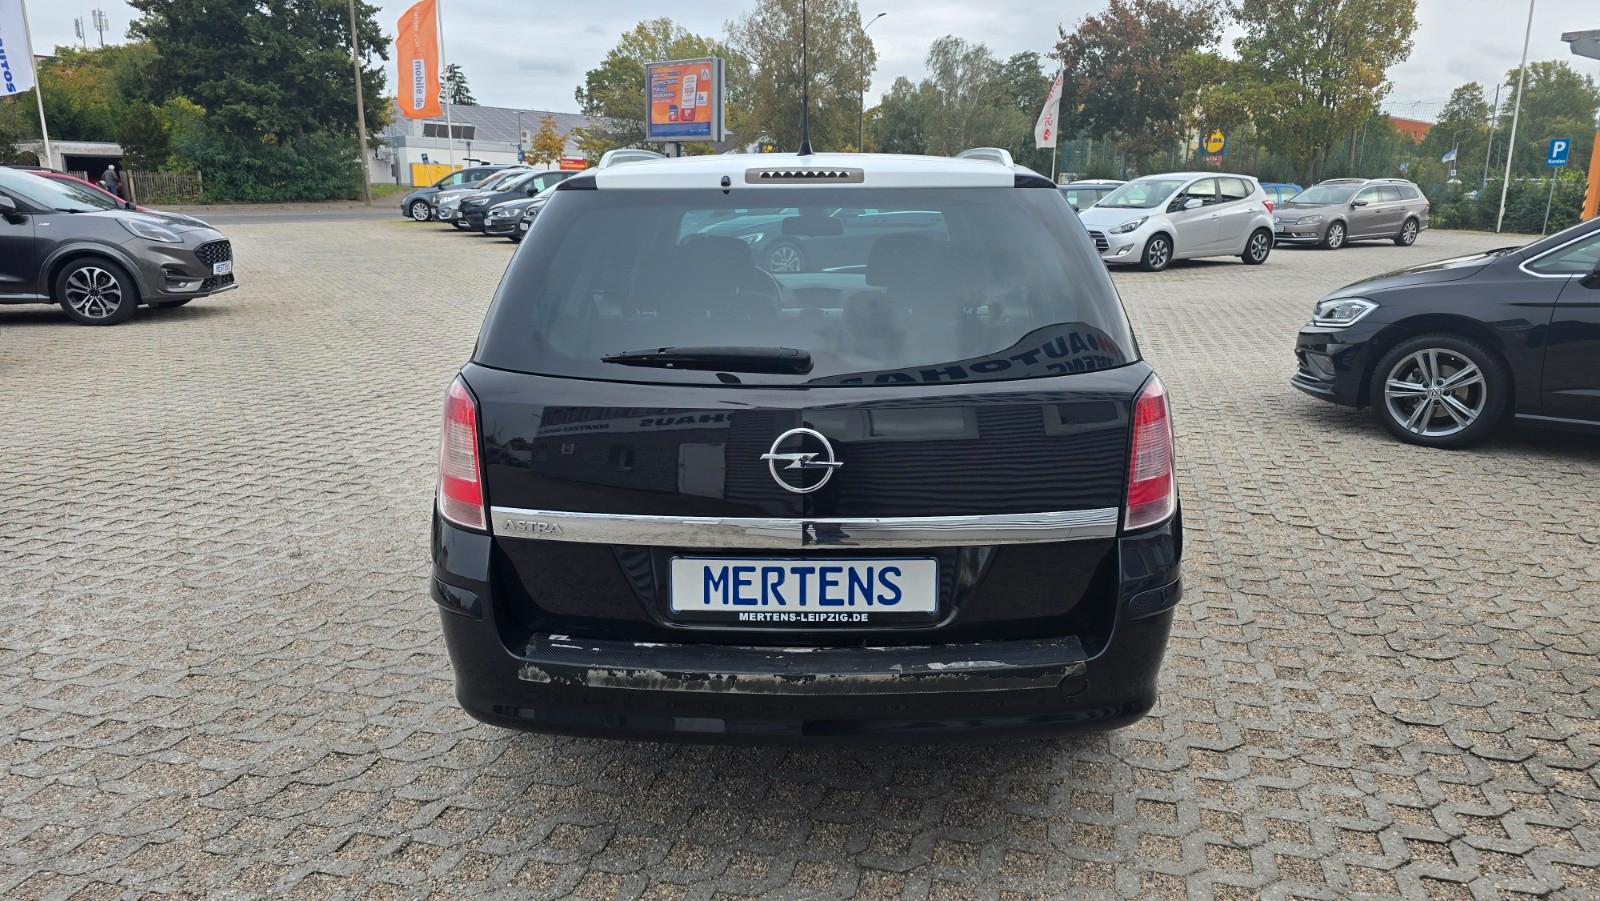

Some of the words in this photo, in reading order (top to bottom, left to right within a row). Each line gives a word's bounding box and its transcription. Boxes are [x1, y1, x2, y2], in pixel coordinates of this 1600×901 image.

[414, 60, 425, 109] mobile.de
[1552, 141, 1567, 158] P
[504, 519, 564, 534] ASTRA
[703, 565, 903, 606] MERTENS
[739, 612, 869, 622] MERTENS-LEIPZIG.DE
